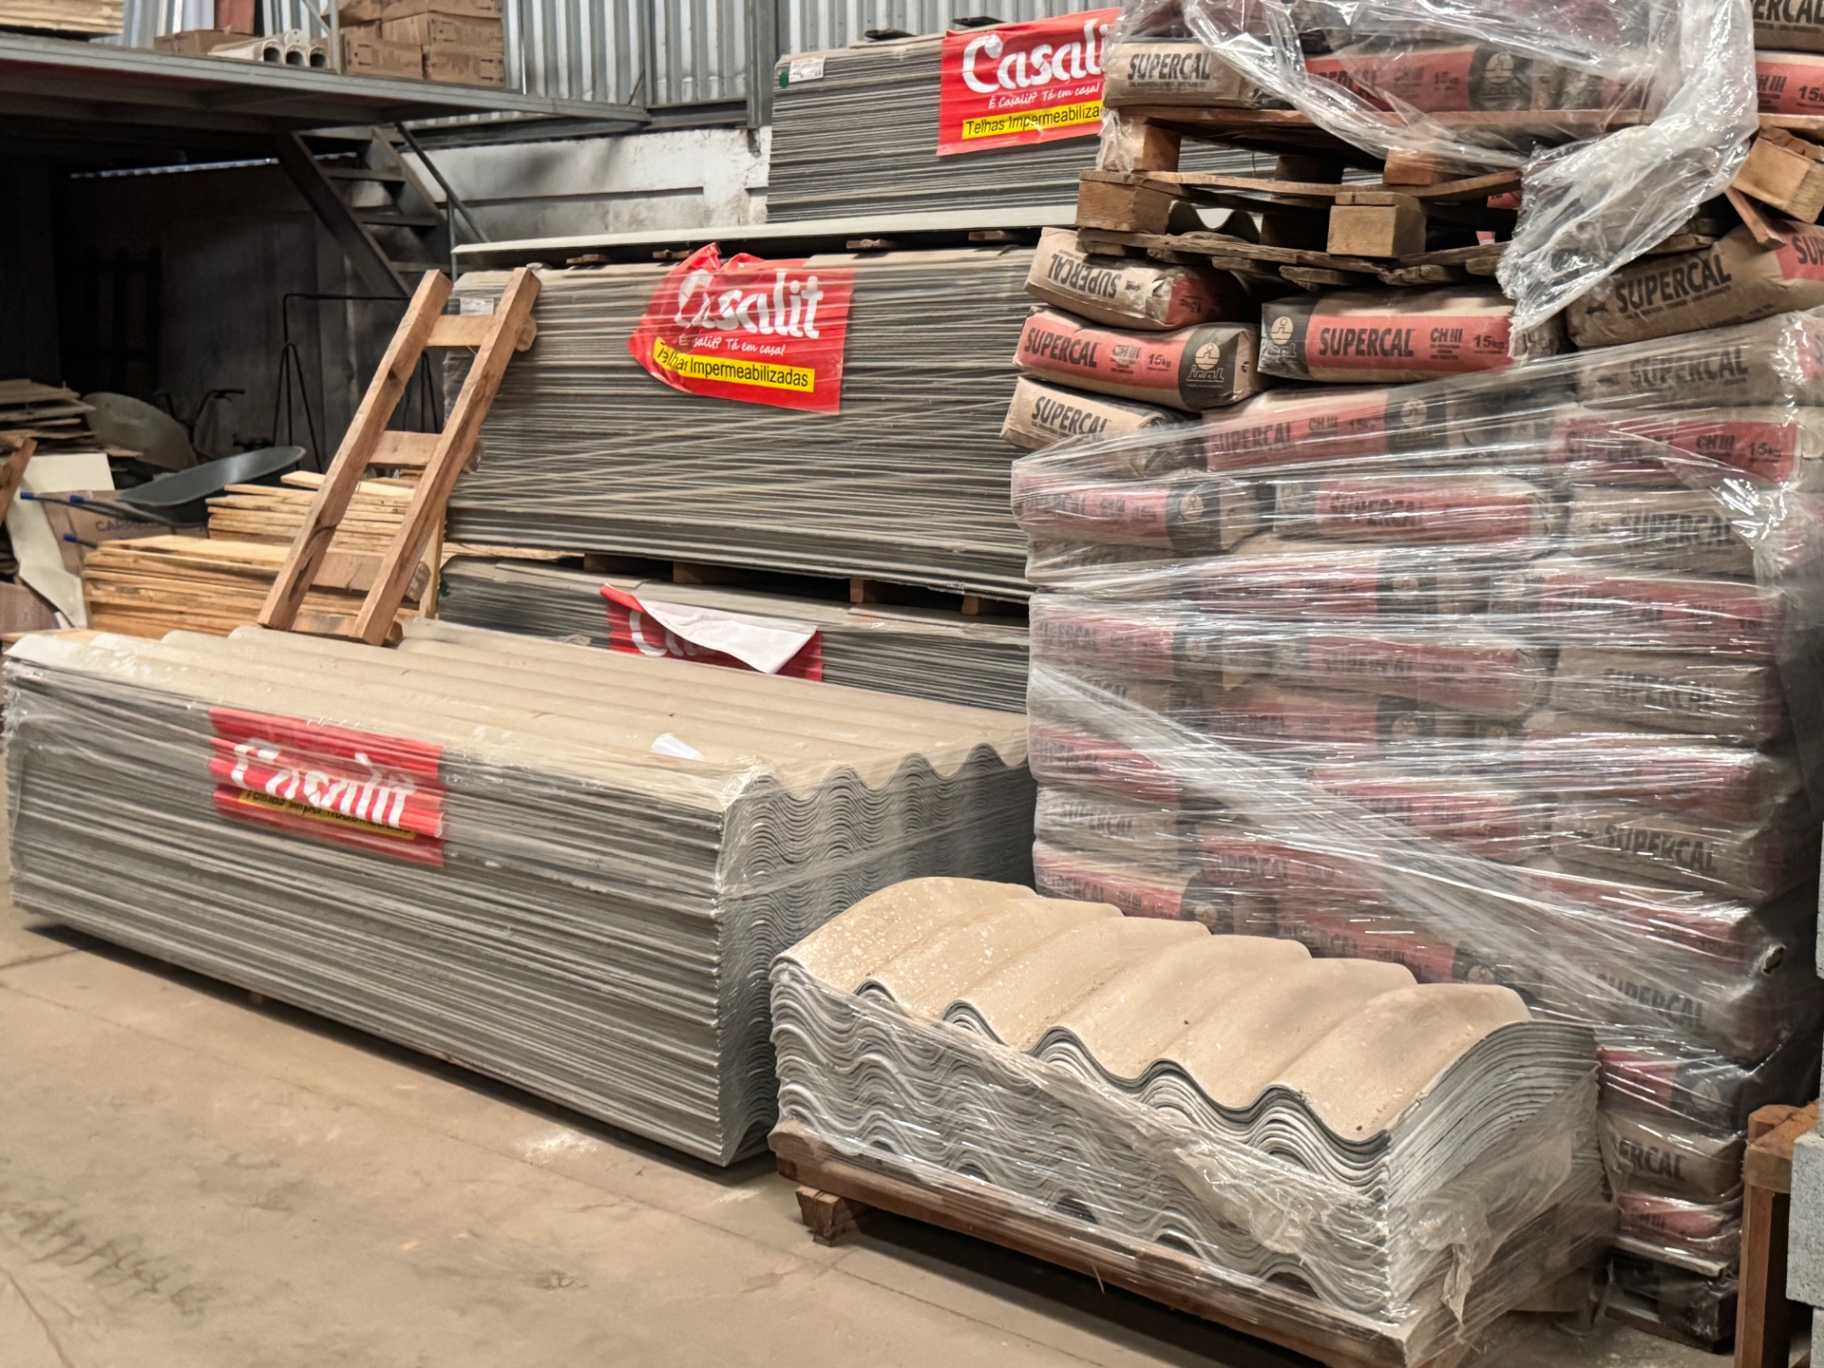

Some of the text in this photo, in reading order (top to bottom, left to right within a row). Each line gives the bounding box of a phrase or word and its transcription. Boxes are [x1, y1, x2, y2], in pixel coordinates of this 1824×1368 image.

[1127, 53, 1211, 82] SUPERCAL
[1057, 90, 1073, 99] em
[965, 105, 1100, 136] Telhas Impermeabiliza
[1613, 252, 1733, 315] SUPERCAL
[741, 342, 758, 353] em
[1023, 326, 1099, 369] SUPERCAL
[1147, 352, 1172, 369] 15kg
[1317, 326, 1415, 358] SUPERCAL
[1473, 334, 1506, 351] 15kg
[690, 357, 809, 388] Impermeabilizadas
[1749, 442, 1782, 459] 15kg
